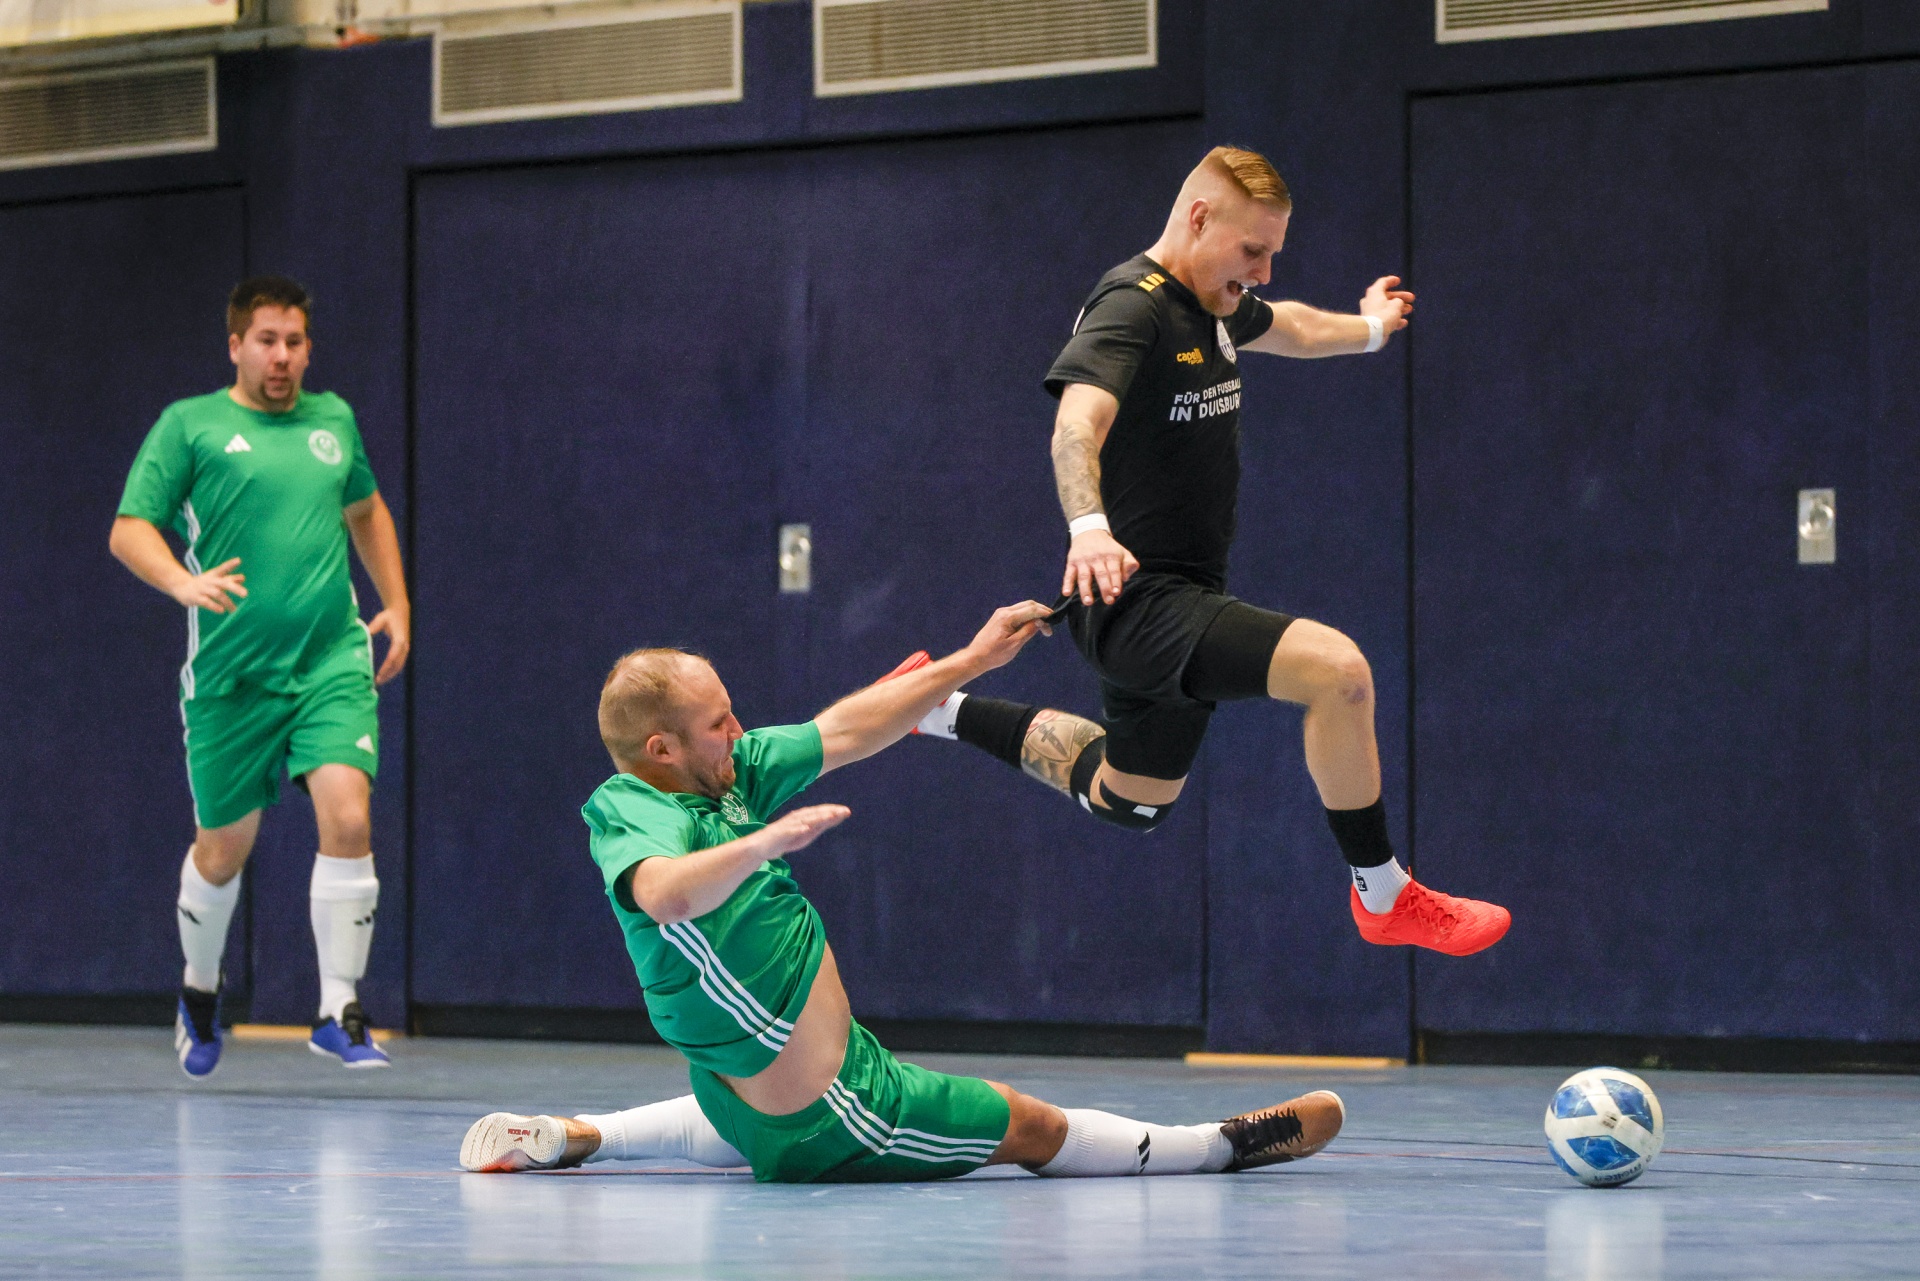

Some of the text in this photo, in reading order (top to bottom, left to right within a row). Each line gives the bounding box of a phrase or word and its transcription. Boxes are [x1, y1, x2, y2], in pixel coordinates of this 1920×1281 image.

[1174, 377, 1241, 404] FÜR DEN FUSSBAL
[1169, 392, 1241, 421] IN DUISBUR
